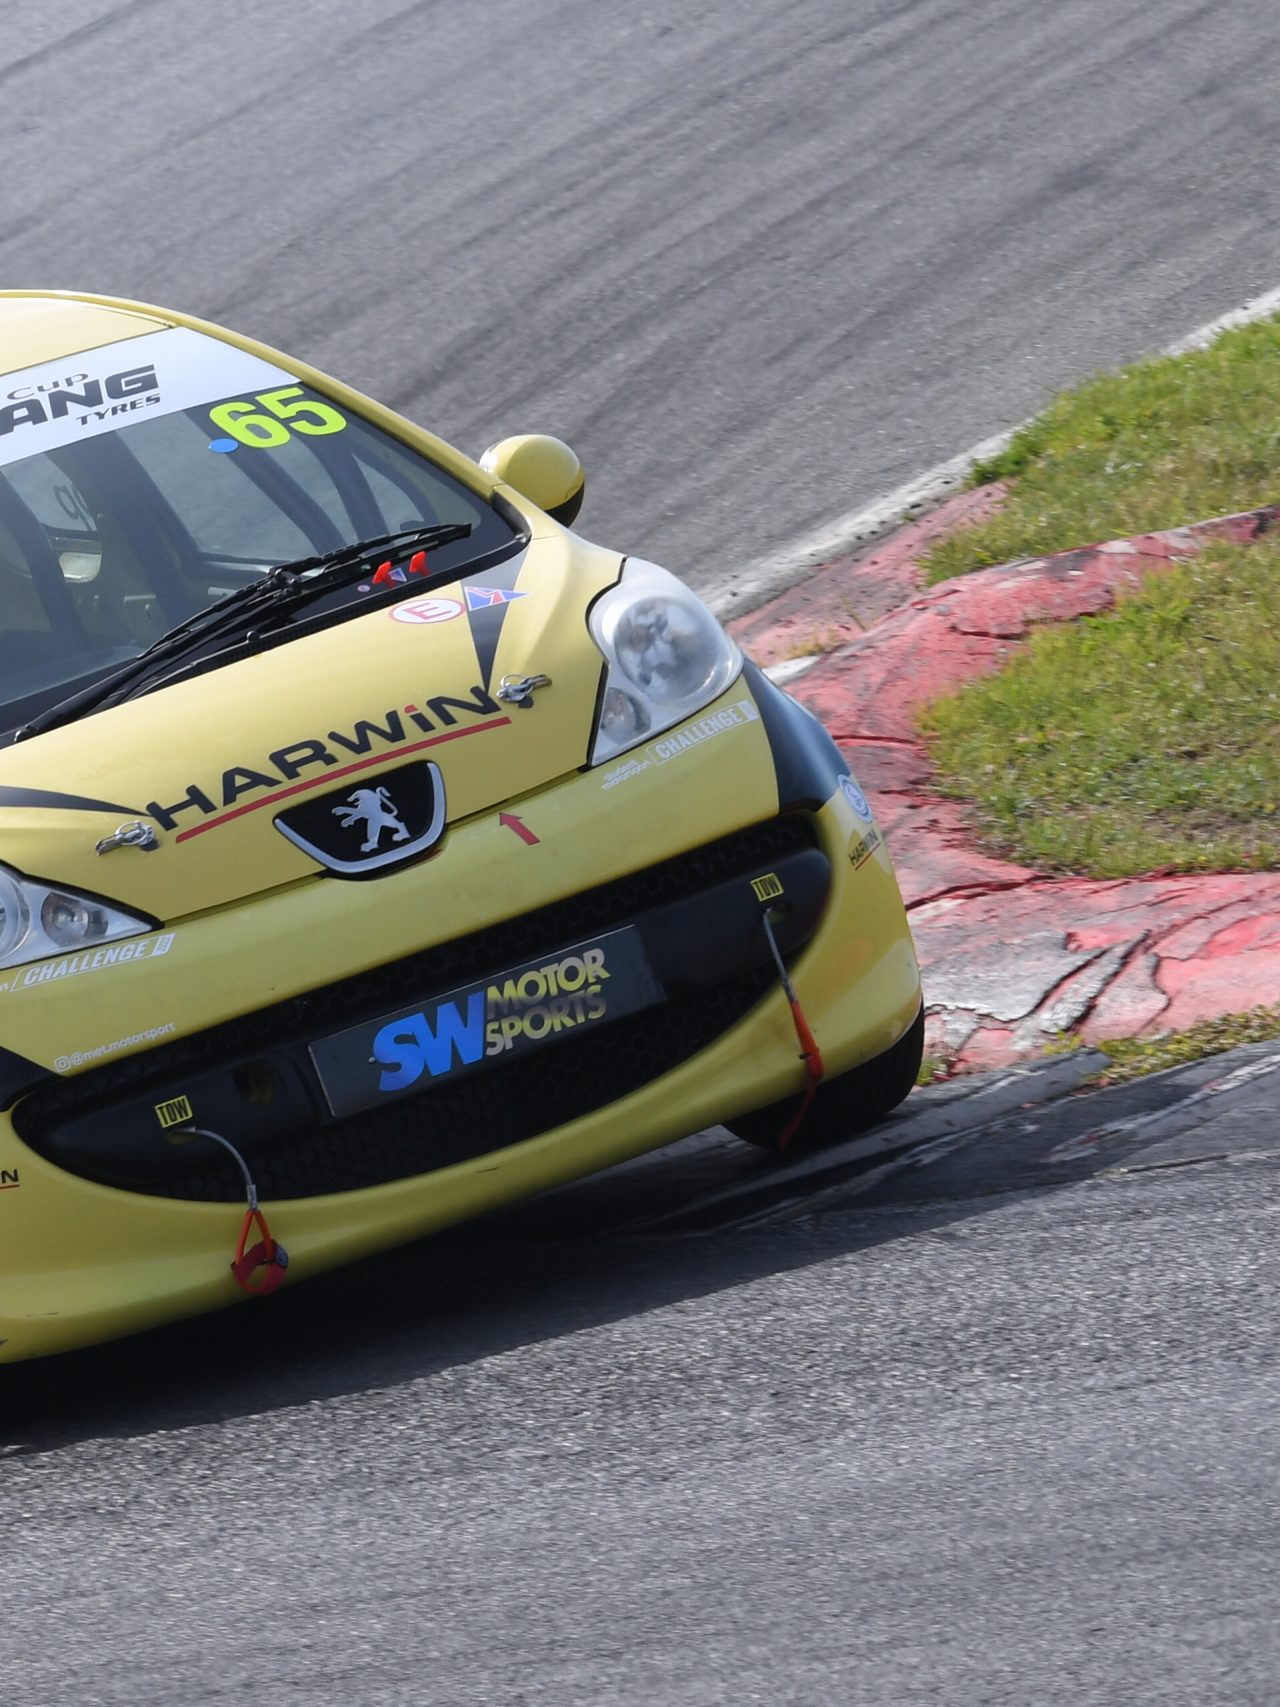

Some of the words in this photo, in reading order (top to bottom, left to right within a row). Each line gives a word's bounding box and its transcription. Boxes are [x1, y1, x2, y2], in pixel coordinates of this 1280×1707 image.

[6, 373, 89, 401] Cup
[75, 393, 161, 426] TYRES
[208, 387, 347, 449] 65
[655, 708, 743, 759] CHALLENGE
[23, 942, 148, 986] CHALLENGE
[486, 947, 612, 1019] MOTOR
[372, 993, 486, 1092] SW
[485, 985, 607, 1056] SPORTS
[158, 1097, 191, 1126] TOW
